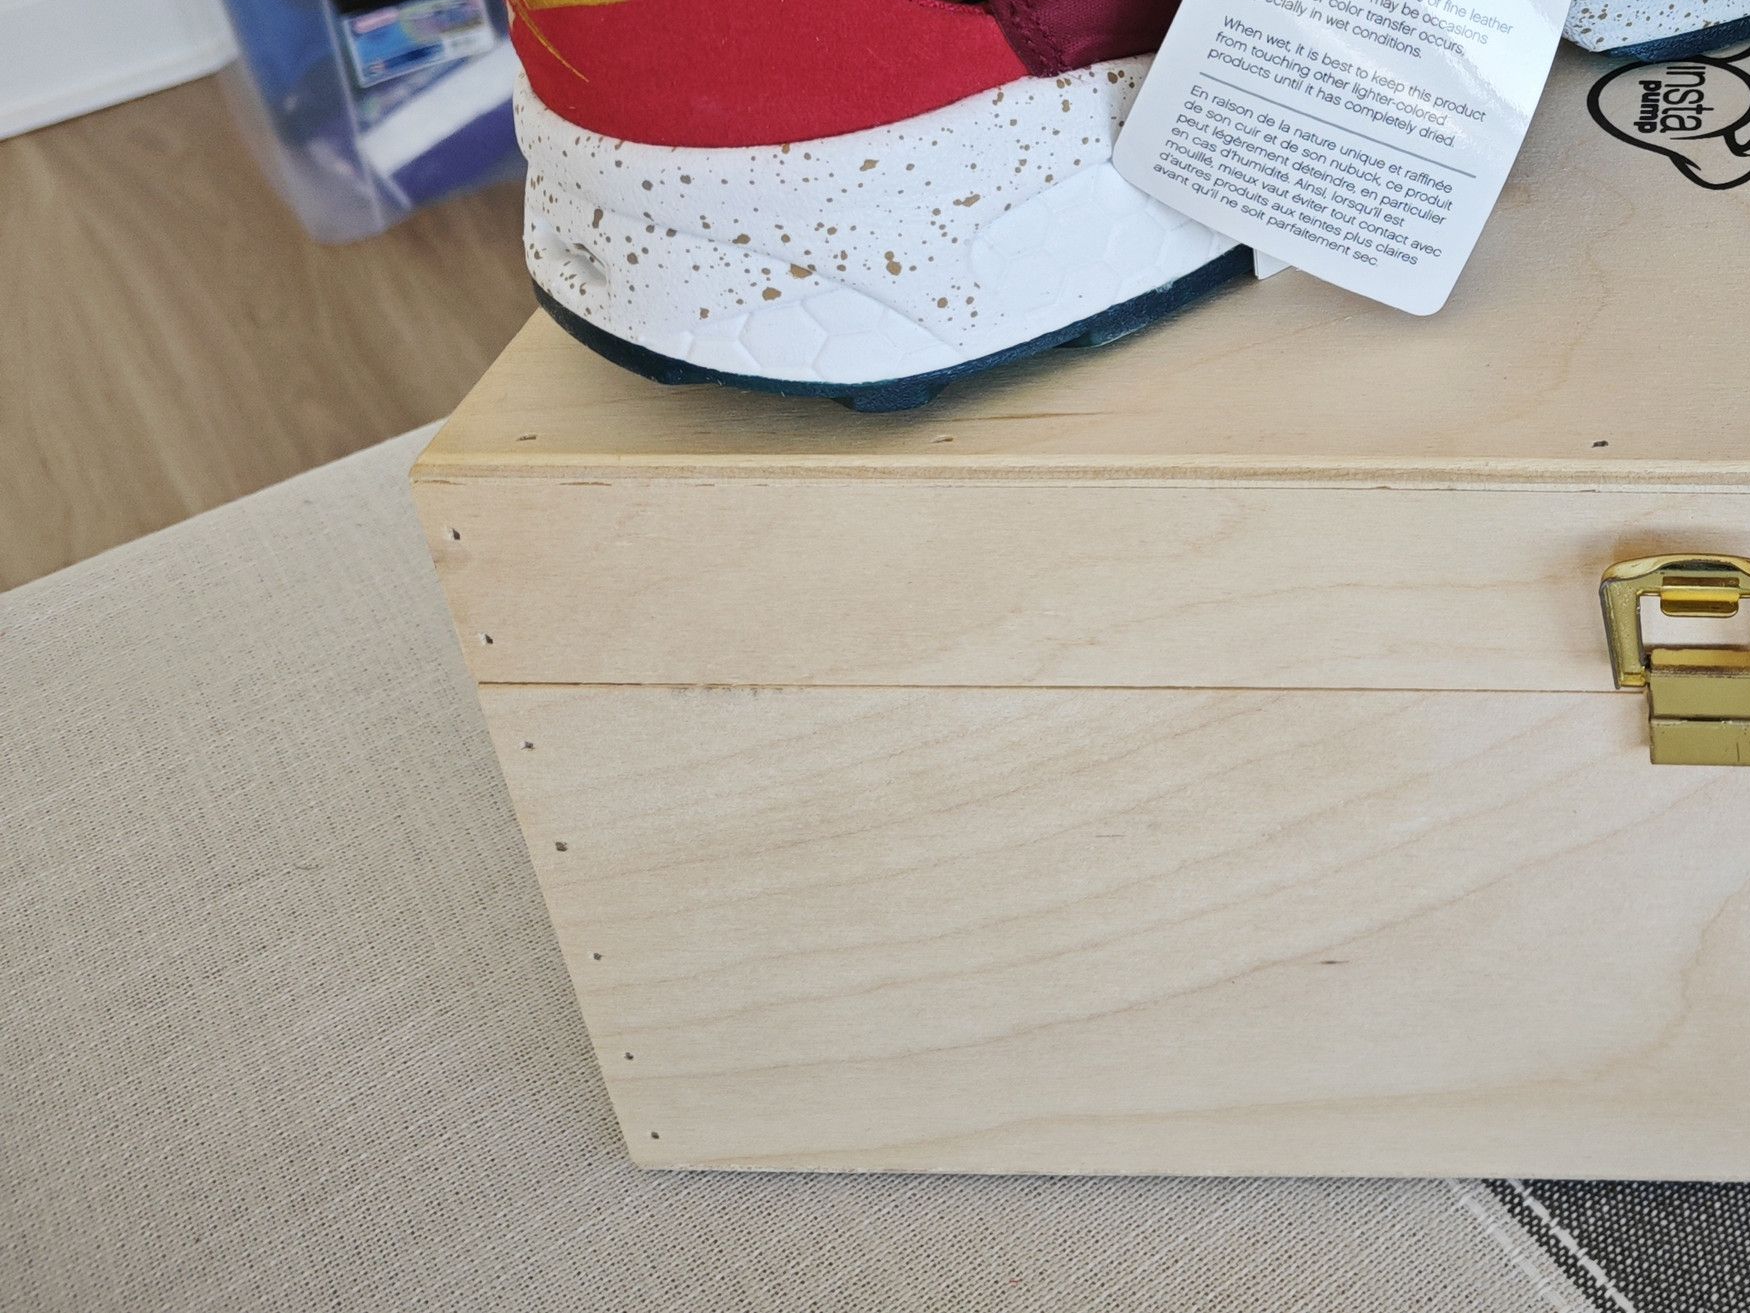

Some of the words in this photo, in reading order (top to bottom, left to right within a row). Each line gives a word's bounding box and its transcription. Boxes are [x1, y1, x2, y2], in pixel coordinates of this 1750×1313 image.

[1309, 6, 1322, 21] in
[1326, 14, 1350, 31] wet
[1351, 25, 1421, 58] conditions.
[1366, 9, 1417, 36] transfer
[1418, 30, 1464, 60] occurs,
[1400, 1, 1419, 19] be
[1421, 13, 1488, 44] occasions
[1443, 0, 1466, 17] fine
[1469, 8, 1513, 33] leather
[1206, 48, 1271, 79] products
[1273, 73, 1305, 91] until
[1304, 82, 1314, 95] it
[1315, 86, 1341, 105] has
[1344, 96, 1417, 134] completely
[1418, 126, 1455, 147] dried.
[1215, 31, 1247, 52] from
[1250, 45, 1311, 79] touching
[1312, 71, 1350, 90] other
[1351, 81, 1447, 125] lighter-colored
[1224, 15, 1262, 40] When
[1266, 34, 1291, 53] wet,
[1294, 43, 1305, 55] it
[1306, 47, 1319, 61] is
[1321, 52, 1353, 73] best
[1355, 66, 1368, 79] to
[1370, 70, 1405, 94] keep
[1408, 85, 1431, 102] this
[1432, 96, 1486, 122] product
[1633, 80, 1662, 134] pump
[1171, 127, 1189, 140] en
[1191, 136, 1217, 152] cas
[1293, 174, 1327, 199] Ainsi,
[1330, 190, 1382, 219] lorsqu'il
[1383, 213, 1405, 227] est
[1175, 113, 1210, 133] peut
[1209, 125, 1289, 166] légèrement
[1291, 160, 1356, 194] déteindre,
[1360, 187, 1378, 200] en
[1378, 195, 1446, 224] particulier
[1183, 100, 1203, 113] de
[1205, 109, 1231, 126] son
[1234, 121, 1261, 137] cuir
[1263, 133, 1278, 145] et
[1279, 139, 1298, 153] de
[1301, 148, 1327, 164] son
[1329, 159, 1381, 186] nubuck,
[1385, 180, 1403, 192] ce
[1403, 187, 1453, 211] produit
[1190, 84, 1208, 100] En
[1211, 95, 1253, 119] raison
[1256, 113, 1275, 126] de
[1277, 119, 1290, 133] la
[1293, 128, 1336, 150] nature
[1339, 145, 1385, 169] unique
[1388, 164, 1403, 175] et
[1403, 169, 1452, 193] raffinée
[1153, 163, 1189, 186] avant
[1191, 182, 1219, 199] qu'il
[1219, 193, 1238, 208] ne
[1240, 204, 1265, 220] soit
[1265, 216, 1351, 255] parfaitement
[1159, 152, 1212, 181] d'autres
[1211, 177, 1269, 210] produits
[1270, 202, 1296, 218] aux
[1298, 211, 1342, 236] teintes
[1342, 231, 1373, 248] plus
[1375, 243, 1418, 265] claires
[1163, 139, 1214, 168] mouillé,
[1217, 163, 1259, 186] mieux
[1261, 181, 1289, 199] vaut
[1291, 191, 1329, 213] éviter
[1330, 203, 1359, 225] tout
[1358, 219, 1409, 245] contact
[1410, 240, 1442, 257] avec
